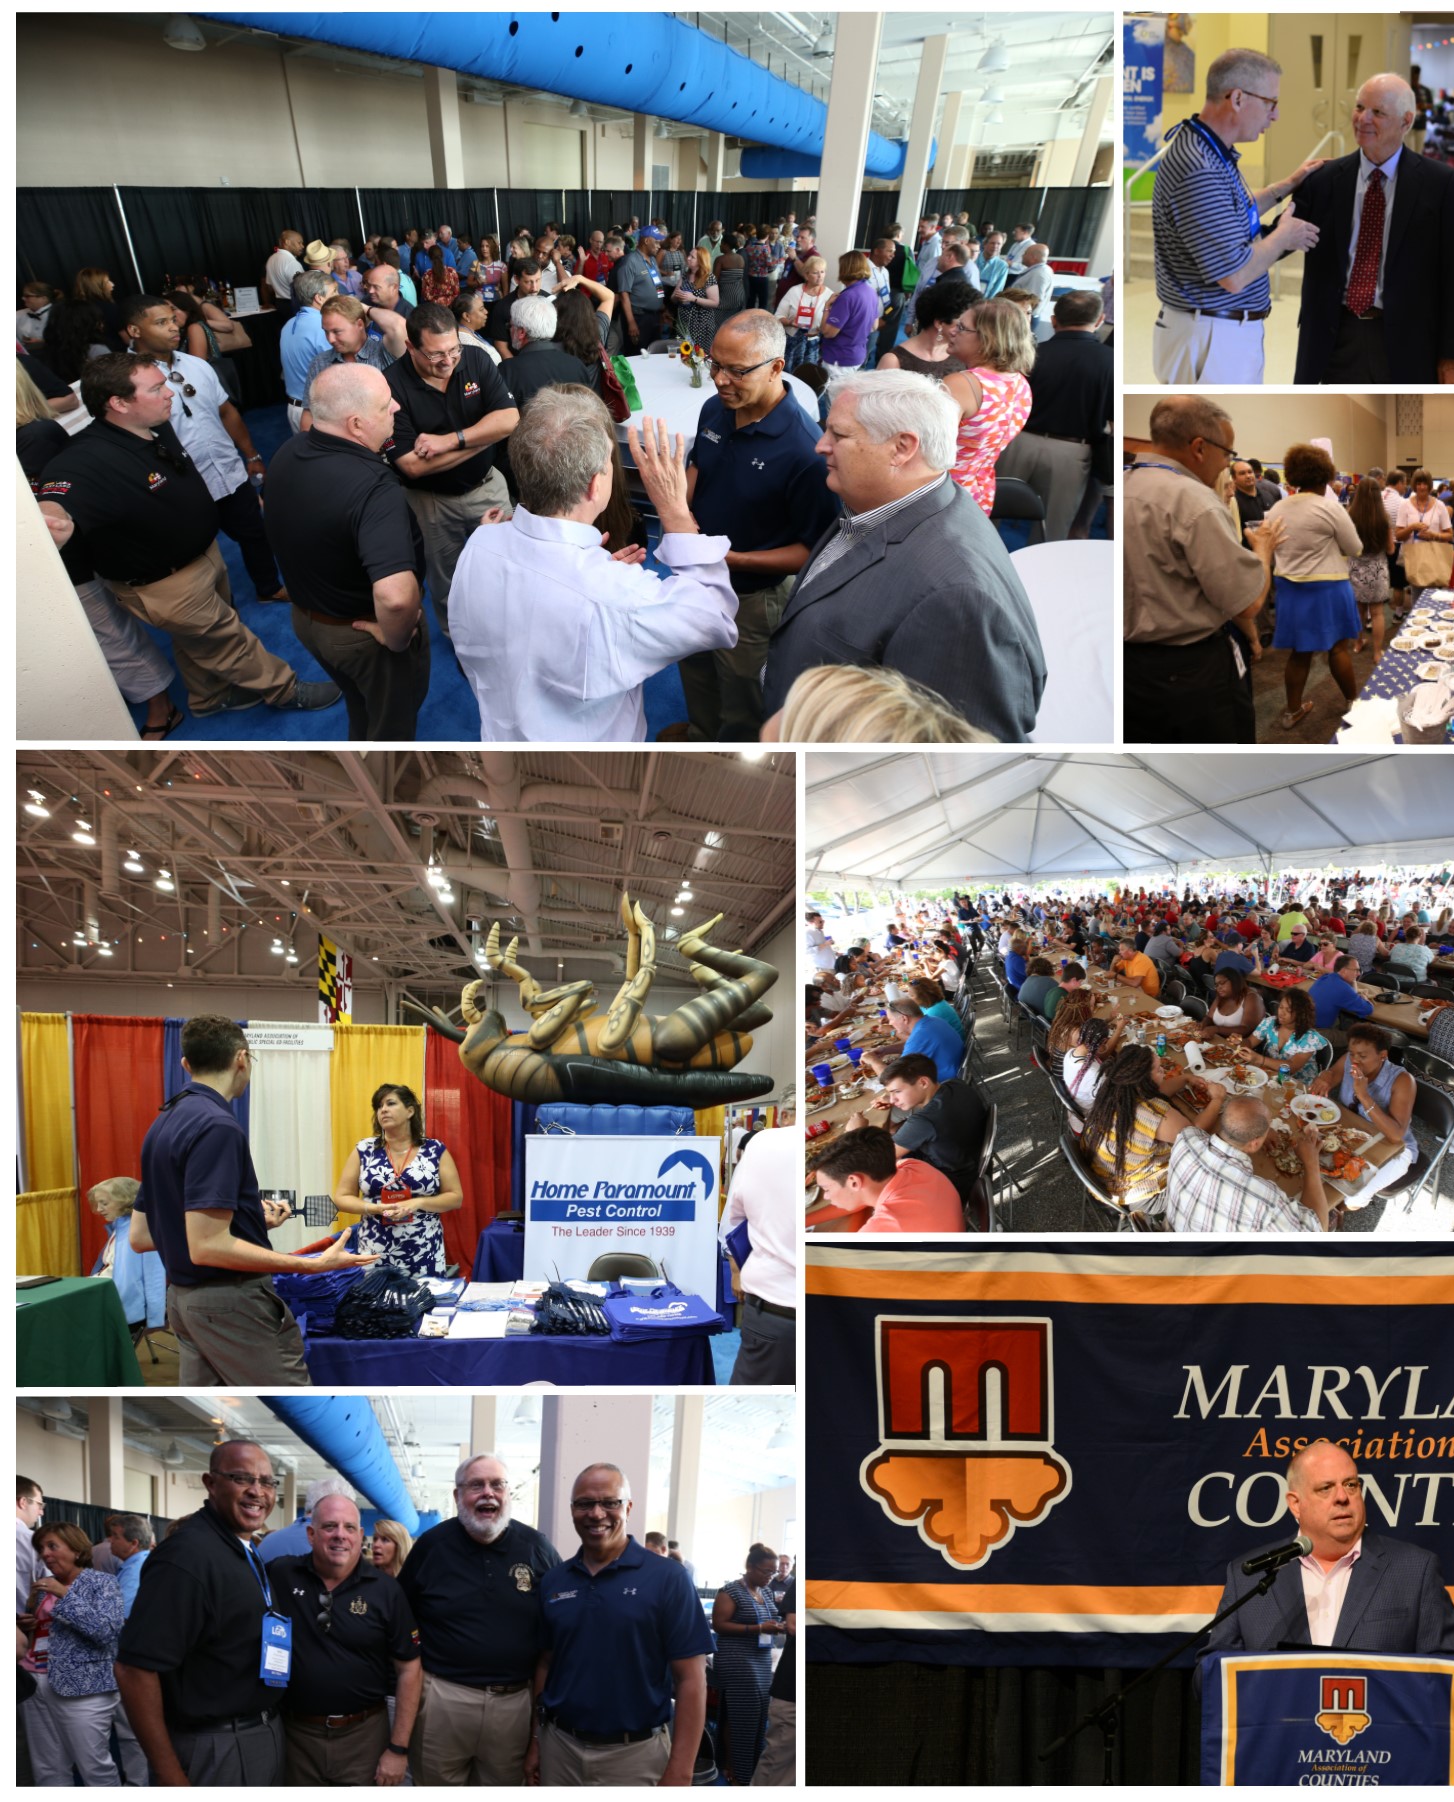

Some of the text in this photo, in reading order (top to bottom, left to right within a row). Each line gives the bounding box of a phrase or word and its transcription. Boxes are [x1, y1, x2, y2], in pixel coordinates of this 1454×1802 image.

[1141, 66, 1156, 81] IS
[531, 1180, 697, 1199] Home Paramount
[566, 1204, 662, 1218] Pest Control
[552, 1226, 675, 1237] The Leader Since 1939
[1297, 1749, 1392, 1764] MARYLAND
[1312, 1764, 1368, 1774] Association of
[1298, 1774, 1380, 1786] COUNTIES
